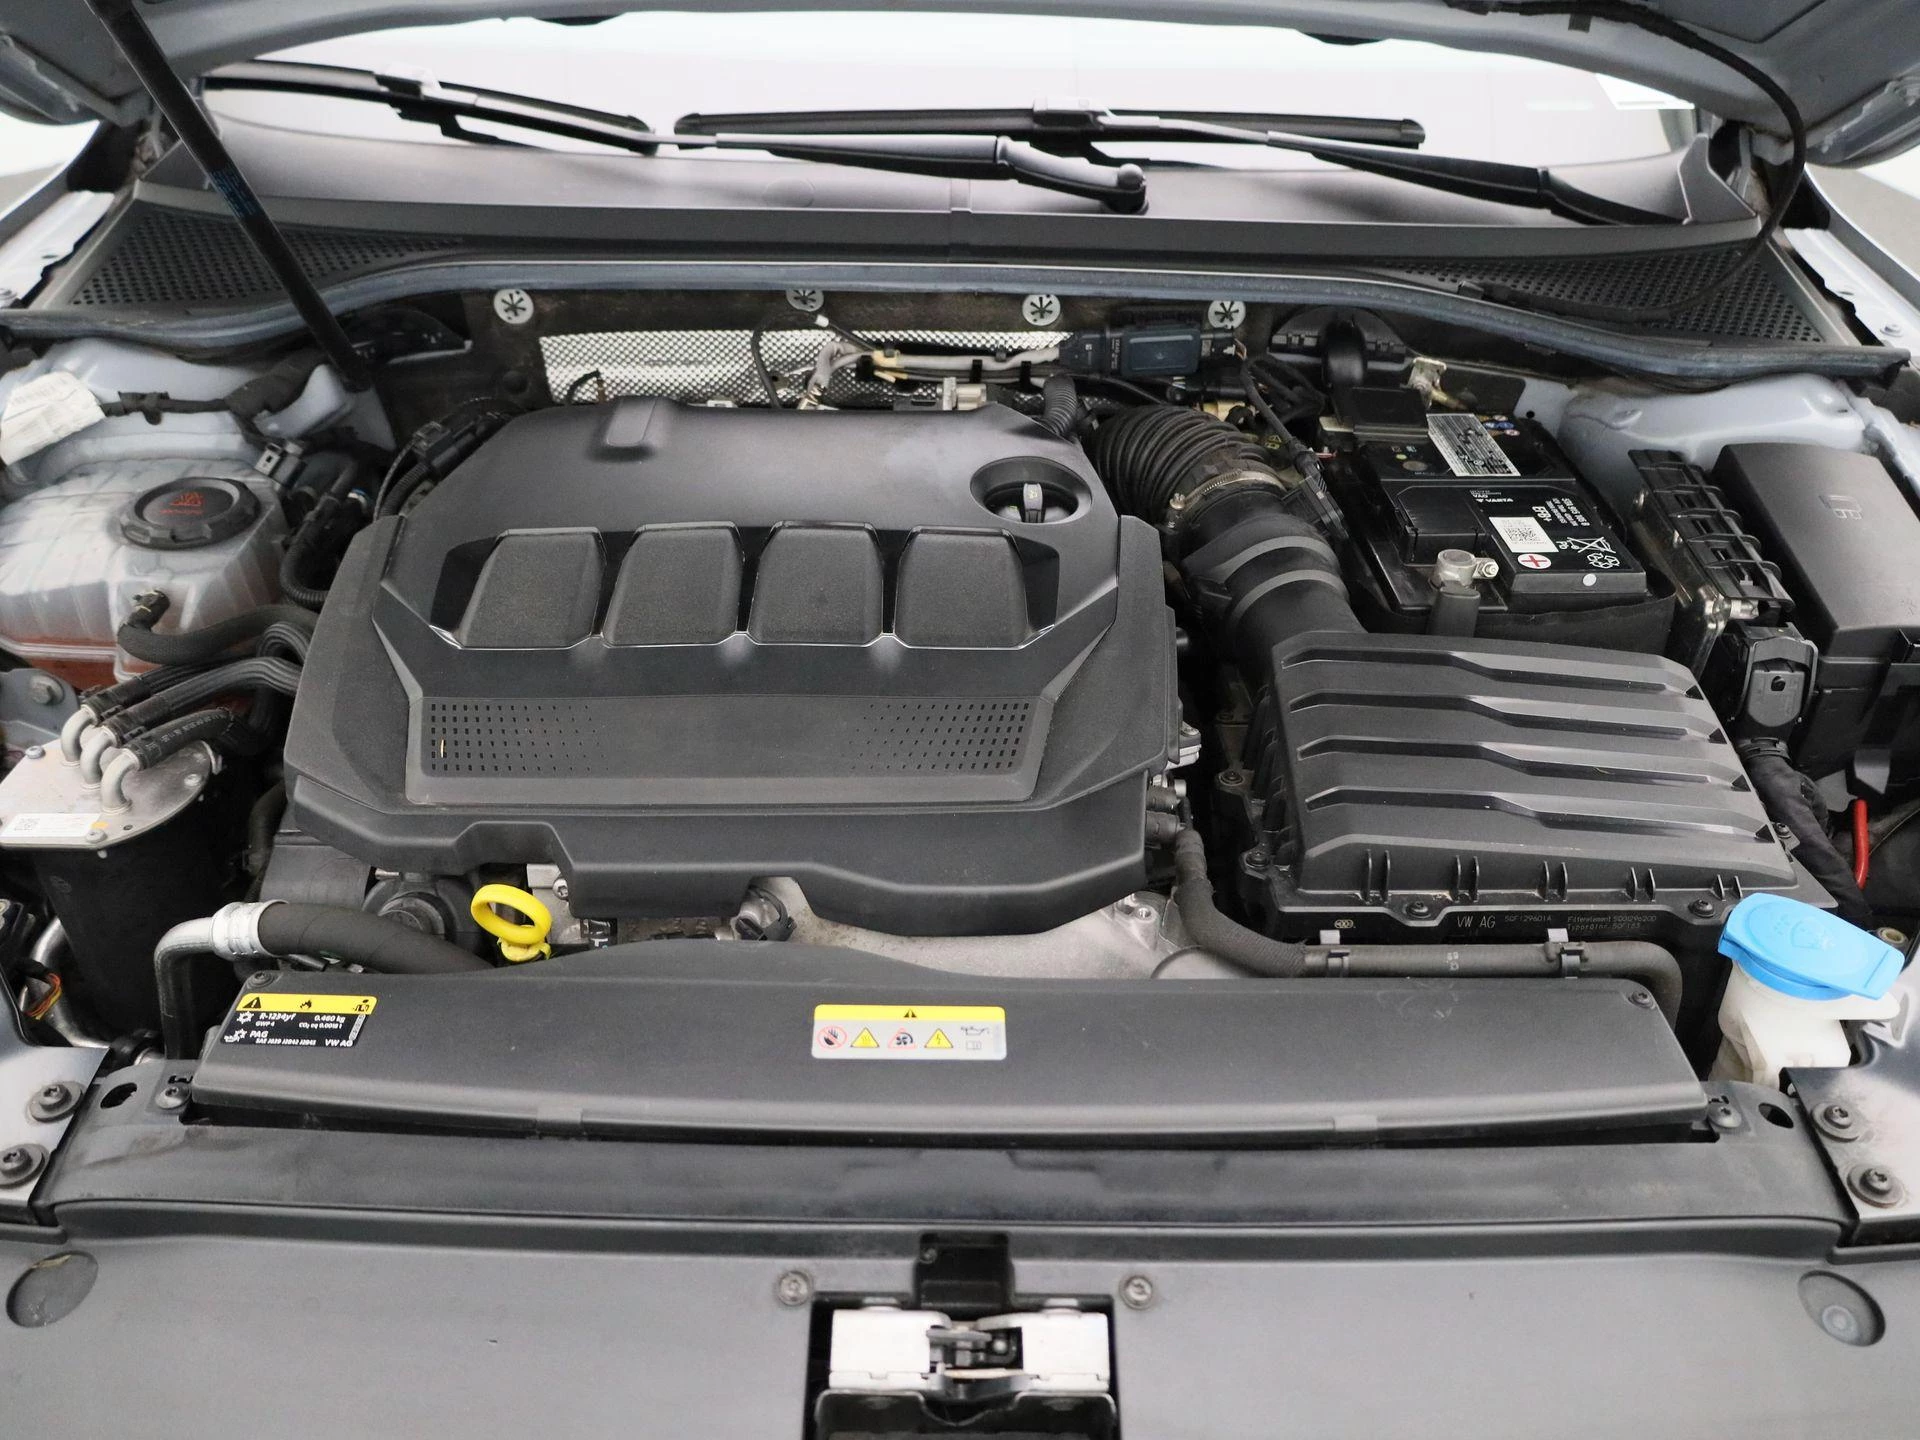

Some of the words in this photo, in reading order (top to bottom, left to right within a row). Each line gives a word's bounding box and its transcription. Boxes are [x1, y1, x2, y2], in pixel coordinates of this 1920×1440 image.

[1531, 505, 1553, 522] EFB+
[1457, 915, 1474, 928] VW
[1479, 915, 1496, 929] AG
[259, 1012, 297, 1022] R-1234yf
[336, 1015, 346, 1024] kg
[249, 1030, 269, 1038] PAG
[325, 1039, 340, 1047] VW
